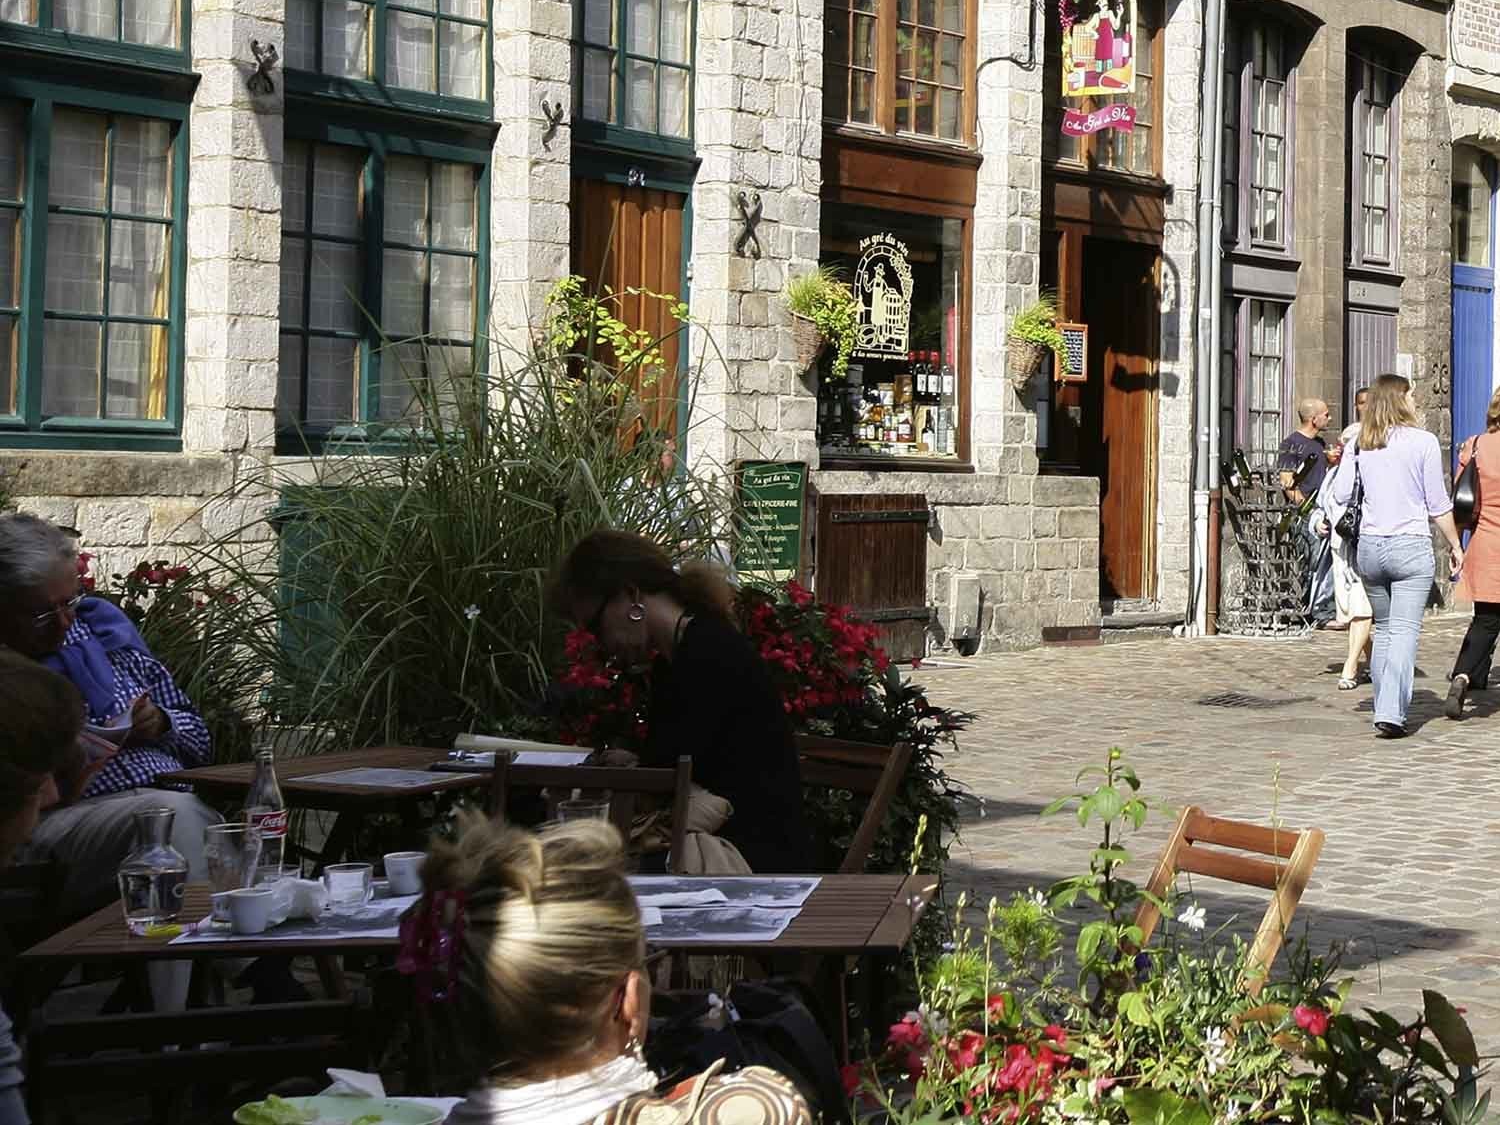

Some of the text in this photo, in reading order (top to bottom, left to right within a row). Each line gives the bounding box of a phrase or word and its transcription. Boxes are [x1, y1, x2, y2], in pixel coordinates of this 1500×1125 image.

[1111, 107, 1131, 122] Vin
[859, 232, 909, 257] Au gré du vin
